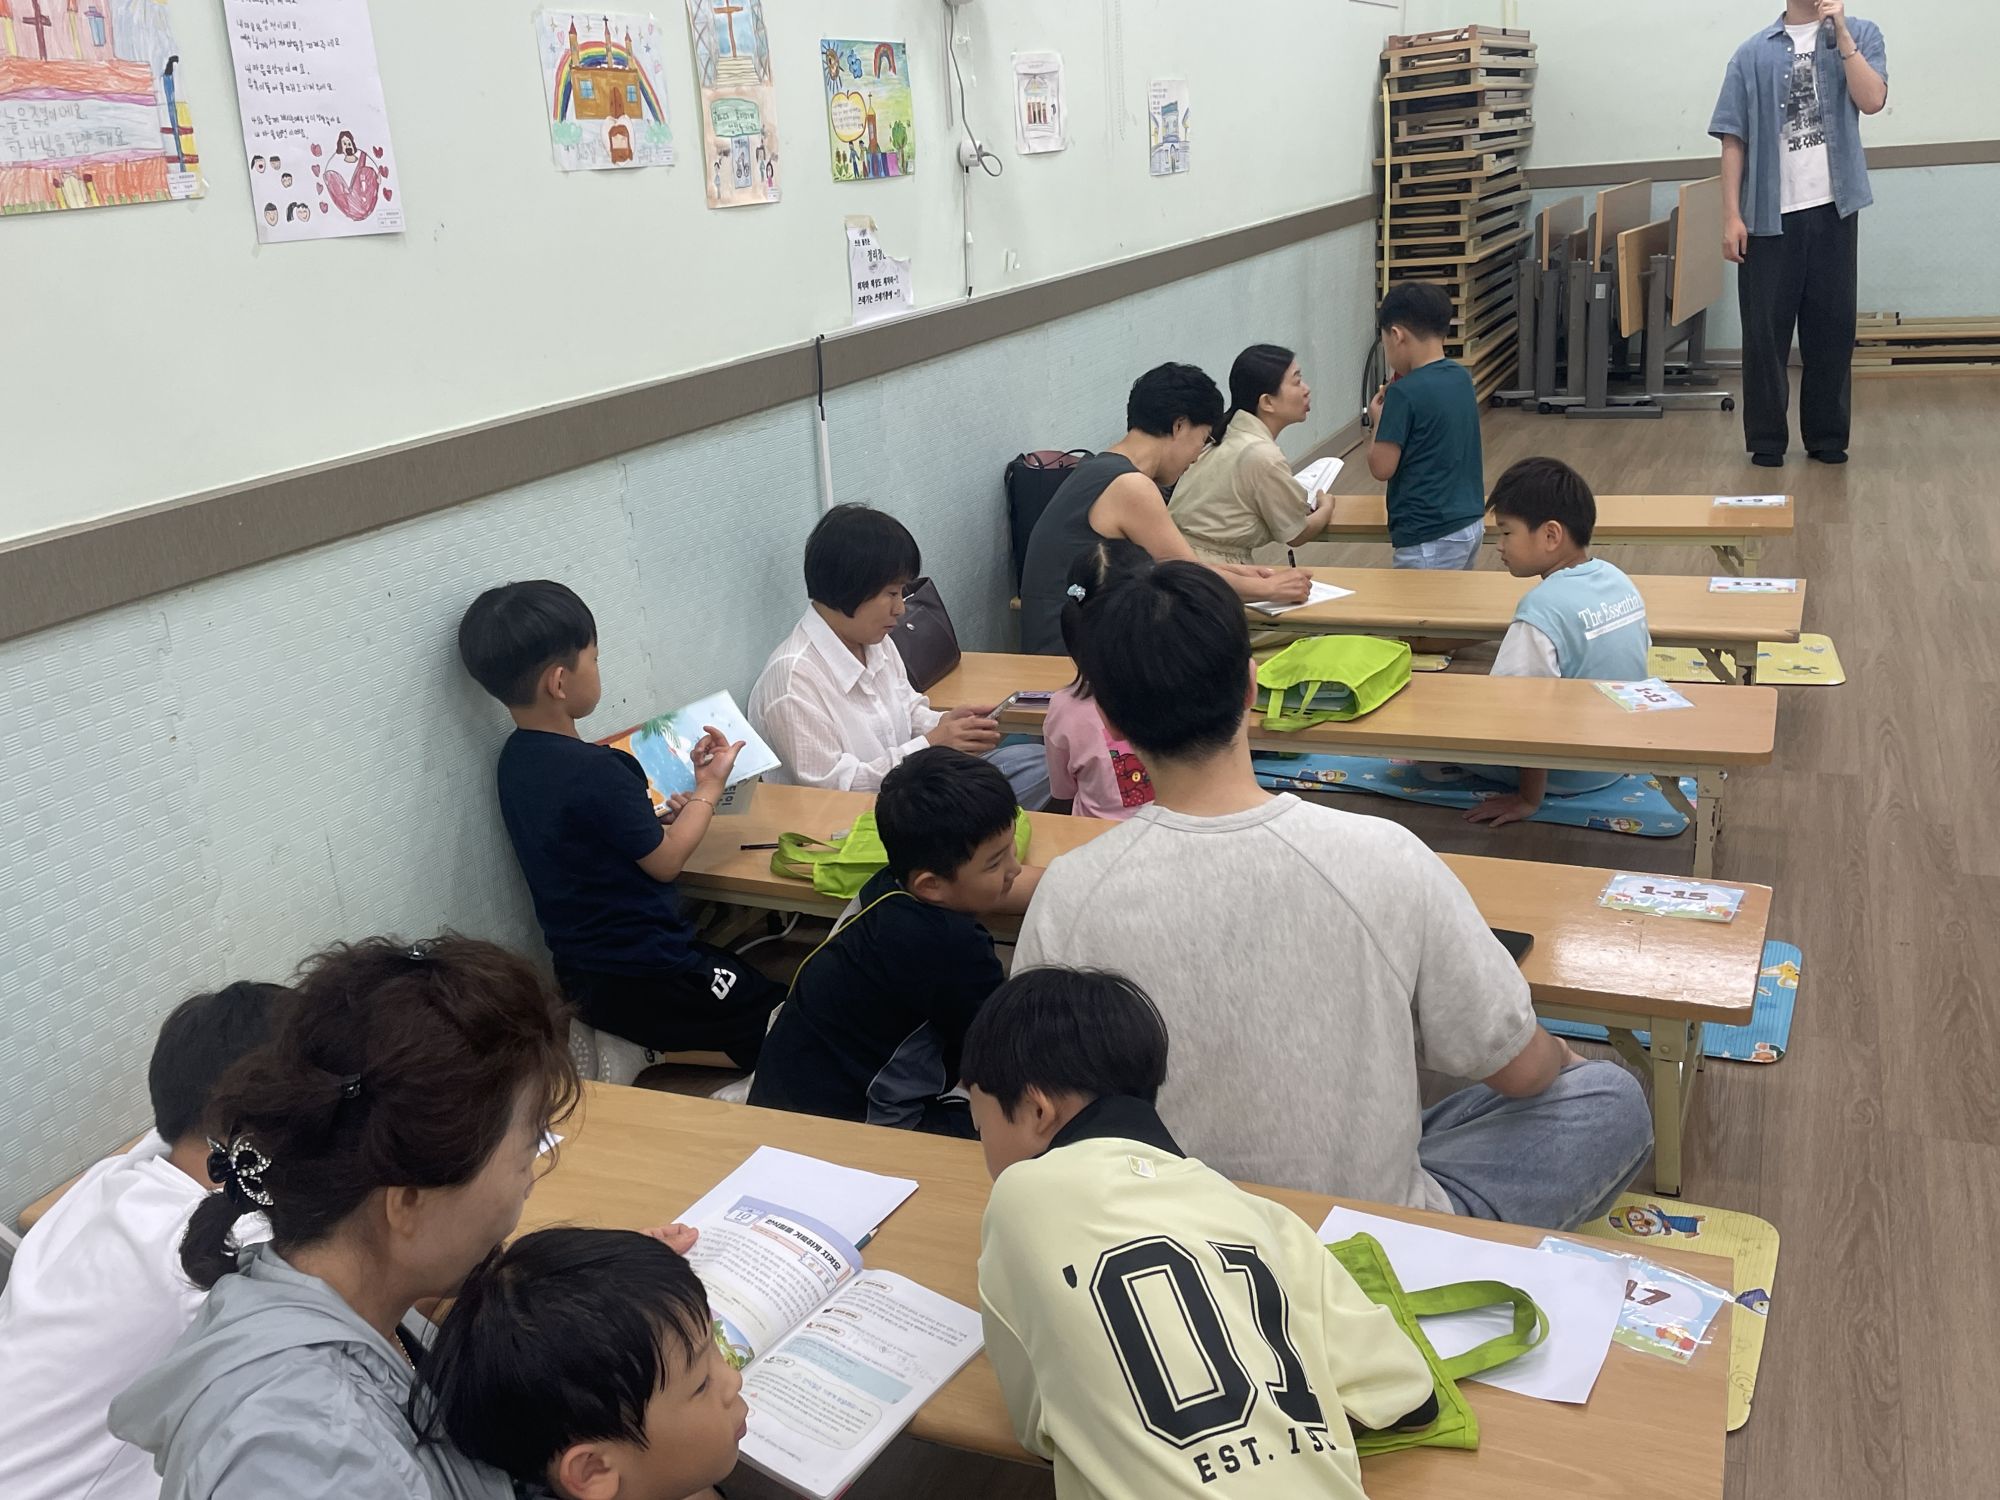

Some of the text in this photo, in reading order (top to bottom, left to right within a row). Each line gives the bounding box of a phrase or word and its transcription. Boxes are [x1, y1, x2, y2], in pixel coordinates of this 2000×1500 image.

[0, 106, 30, 135] 늘은
[1578, 607, 1604, 629] The
[1600, 592, 1641, 621] Essentia
[1640, 884, 1709, 901] 1-15
[1193, 1436, 1274, 1484] EST.
